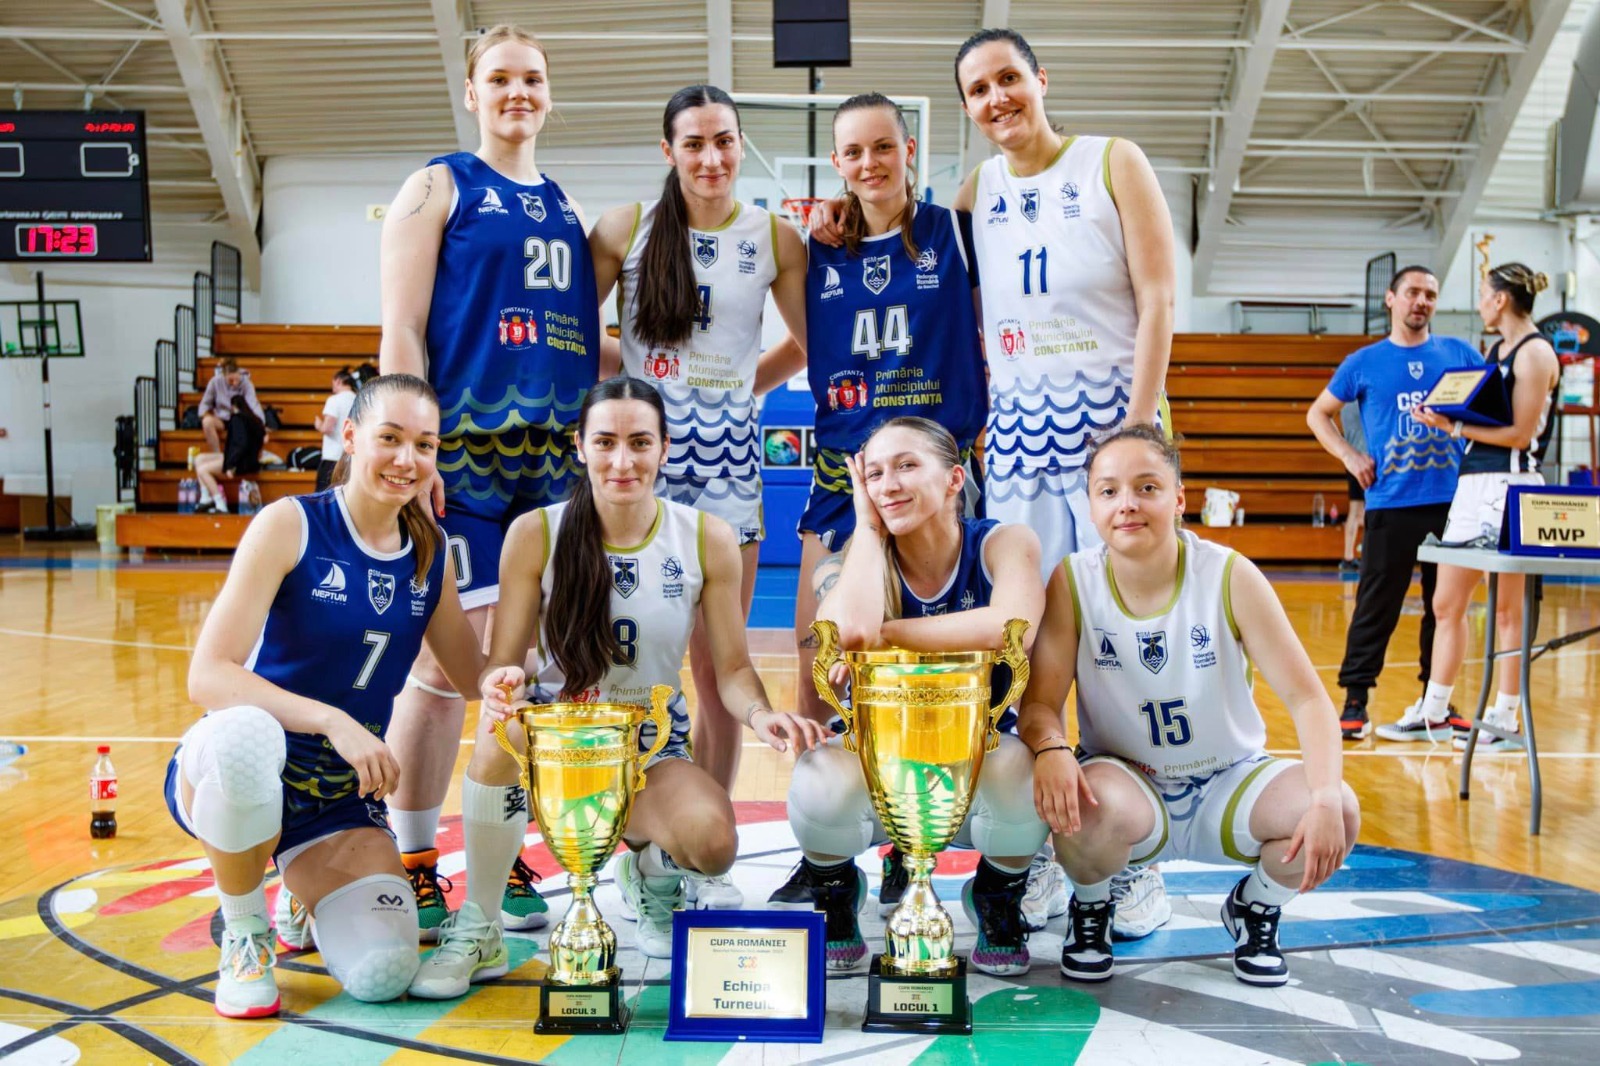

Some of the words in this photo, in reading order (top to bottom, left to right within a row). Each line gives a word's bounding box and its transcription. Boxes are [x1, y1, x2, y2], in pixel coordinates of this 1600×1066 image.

[28, 224, 95, 254] 17:23
[523, 236, 572, 292] 20
[1017, 244, 1051, 298] 11
[693, 282, 714, 333] 4
[1029, 317, 1076, 331] Primăria
[851, 304, 913, 361] 44
[1031, 327, 1094, 344] Municipiului
[875, 367, 924, 382] Primăria
[874, 379, 940, 395] Municipiului
[872, 393, 943, 408] CONSTANȚA
[1396, 389, 1429, 412] CS
[1537, 527, 1585, 543] MVP
[311, 588, 348, 602] NEPTUN
[610, 615, 640, 668] 8
[352, 629, 391, 690] 7
[1094, 658, 1122, 668] NEPTUN
[610, 684, 652, 696] Primări
[1138, 696, 1194, 748] 15
[1164, 756, 1218, 773] Primăria
[710, 938, 735, 947] CUPA
[737, 937, 787, 948] ROMÂNIEI
[723, 980, 771, 994] Echipa
[561, 1007, 589, 1015] LOCUL
[590, 1007, 597, 1015] 3
[894, 1002, 931, 1012] LOCUL
[933, 1003, 939, 1012] 1
